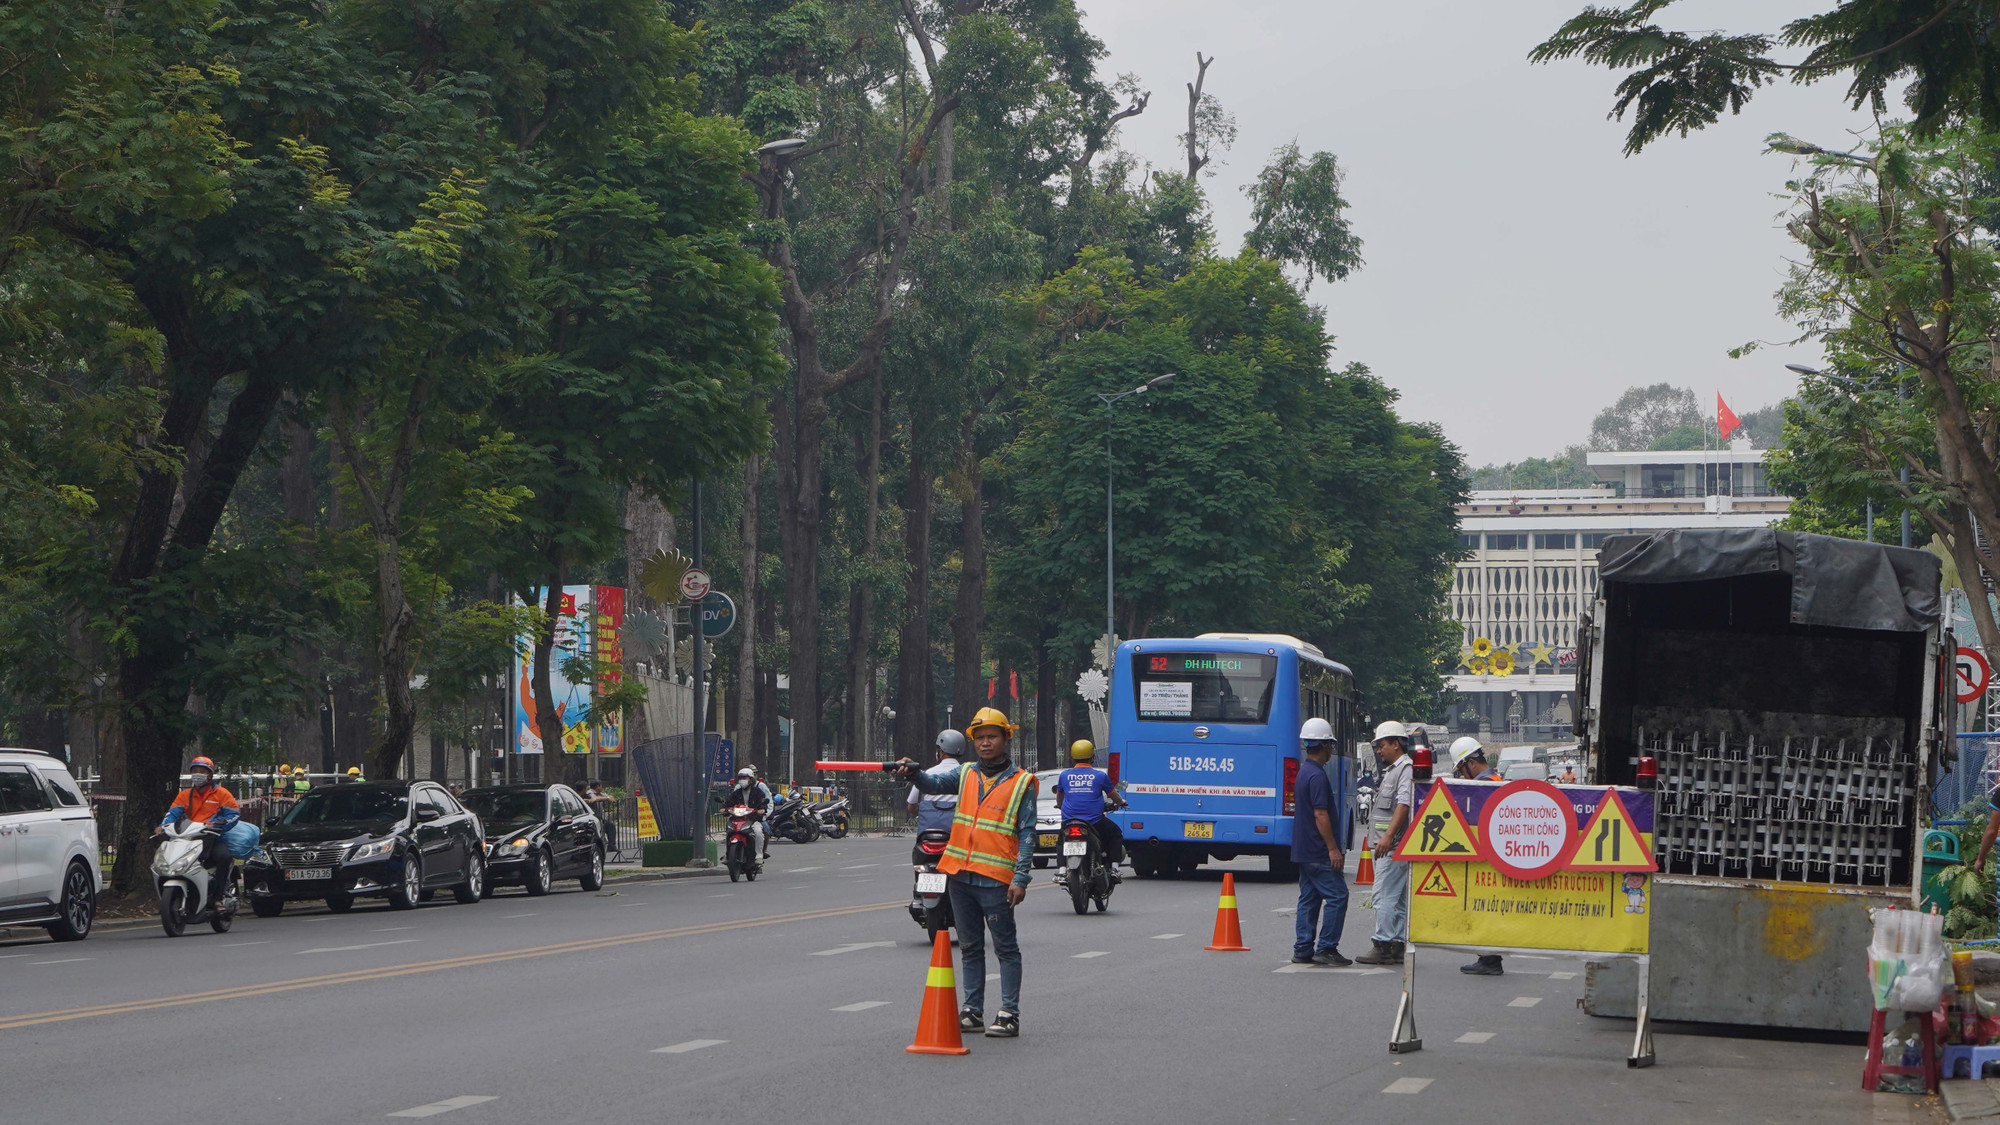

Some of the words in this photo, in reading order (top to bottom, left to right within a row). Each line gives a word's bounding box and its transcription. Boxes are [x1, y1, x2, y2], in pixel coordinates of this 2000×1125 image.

[1151, 657, 1168, 670] 52
[1185, 660, 1199, 669] ĐH
[1202, 660, 1241, 670] HUTECH
[1169, 756, 1235, 772] 51B-245.45
[1499, 805, 1521, 819] CÔNG
[1523, 805, 1558, 819] TRƯỜNG
[1192, 823, 1206, 831] 51B
[1498, 824, 1521, 836] ĐANG
[1523, 824, 1535, 836] THI
[1537, 822, 1559, 836] CÔNG
[1505, 841, 1550, 857] 5km/h
[1475, 871, 1497, 887] AREA
[1535, 874, 1605, 892] CONSTRUCTION
[1473, 898, 1486, 912] XIN
[1501, 896, 1515, 915] QUÝ
[1516, 896, 1538, 914] KHÁCH
[1592, 900, 1606, 917] NÀY
